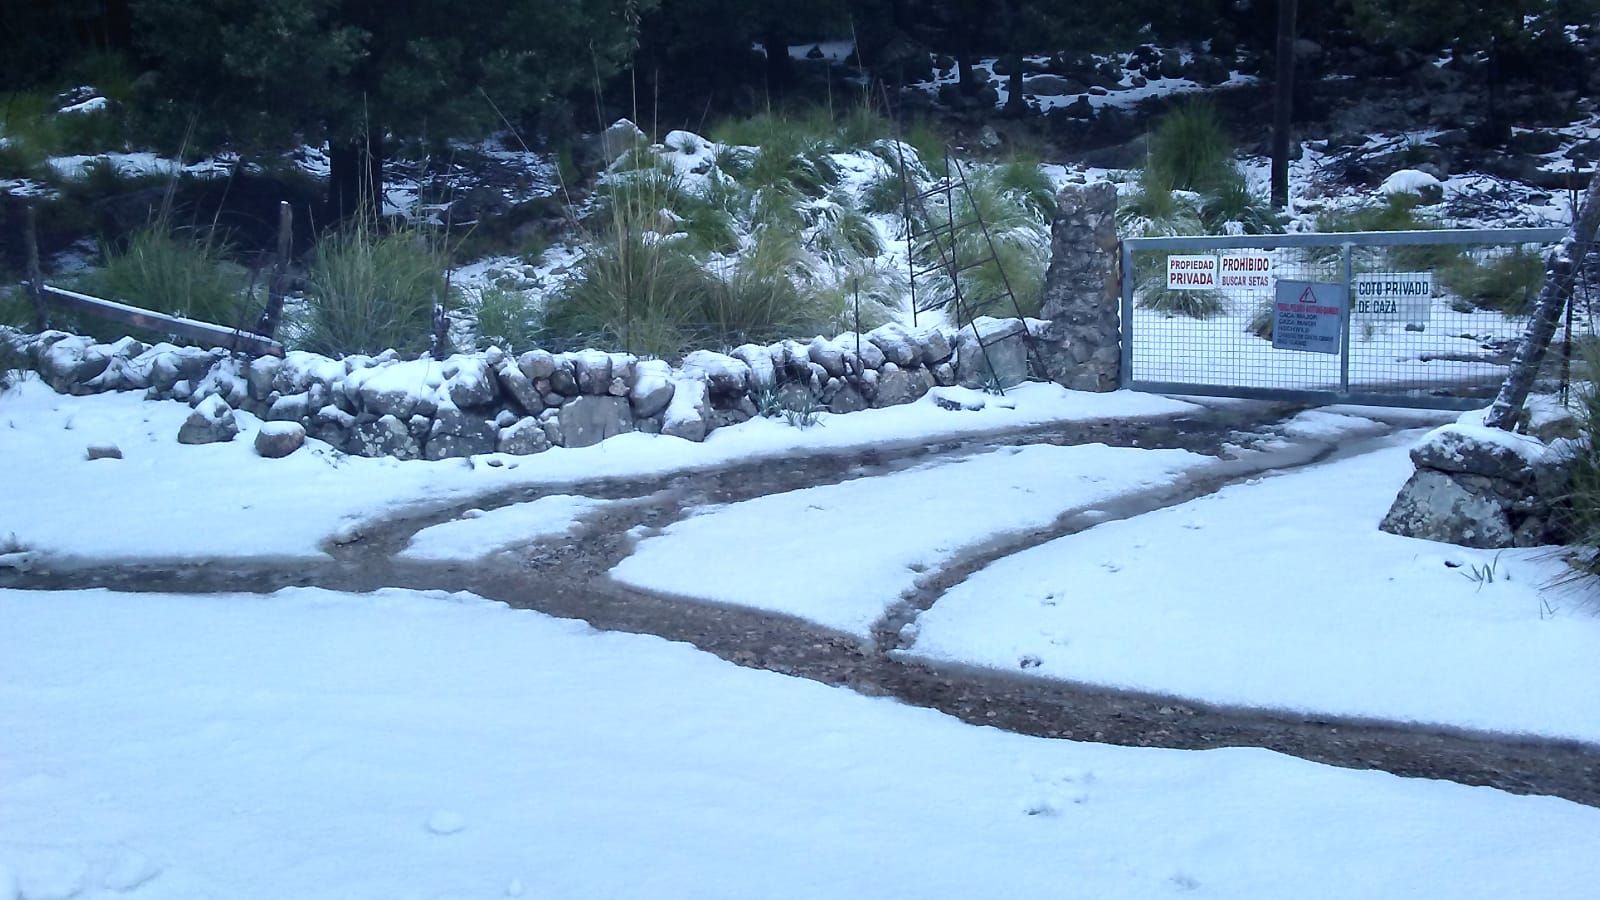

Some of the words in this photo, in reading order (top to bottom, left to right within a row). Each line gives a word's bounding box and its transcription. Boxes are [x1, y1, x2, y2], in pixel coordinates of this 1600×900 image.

[1170, 259, 1214, 270] PROPIEDAD
[1222, 257, 1270, 272] PROHIBIDO
[1170, 273, 1214, 286] PRIVADA
[1221, 276, 1247, 287] BUSCAR
[1248, 276, 1269, 287] SETAS
[1358, 281, 1383, 296] COTO
[1385, 281, 1429, 296] PRIVADO
[1358, 301, 1370, 313] DE
[1372, 300, 1397, 314] CAZA
